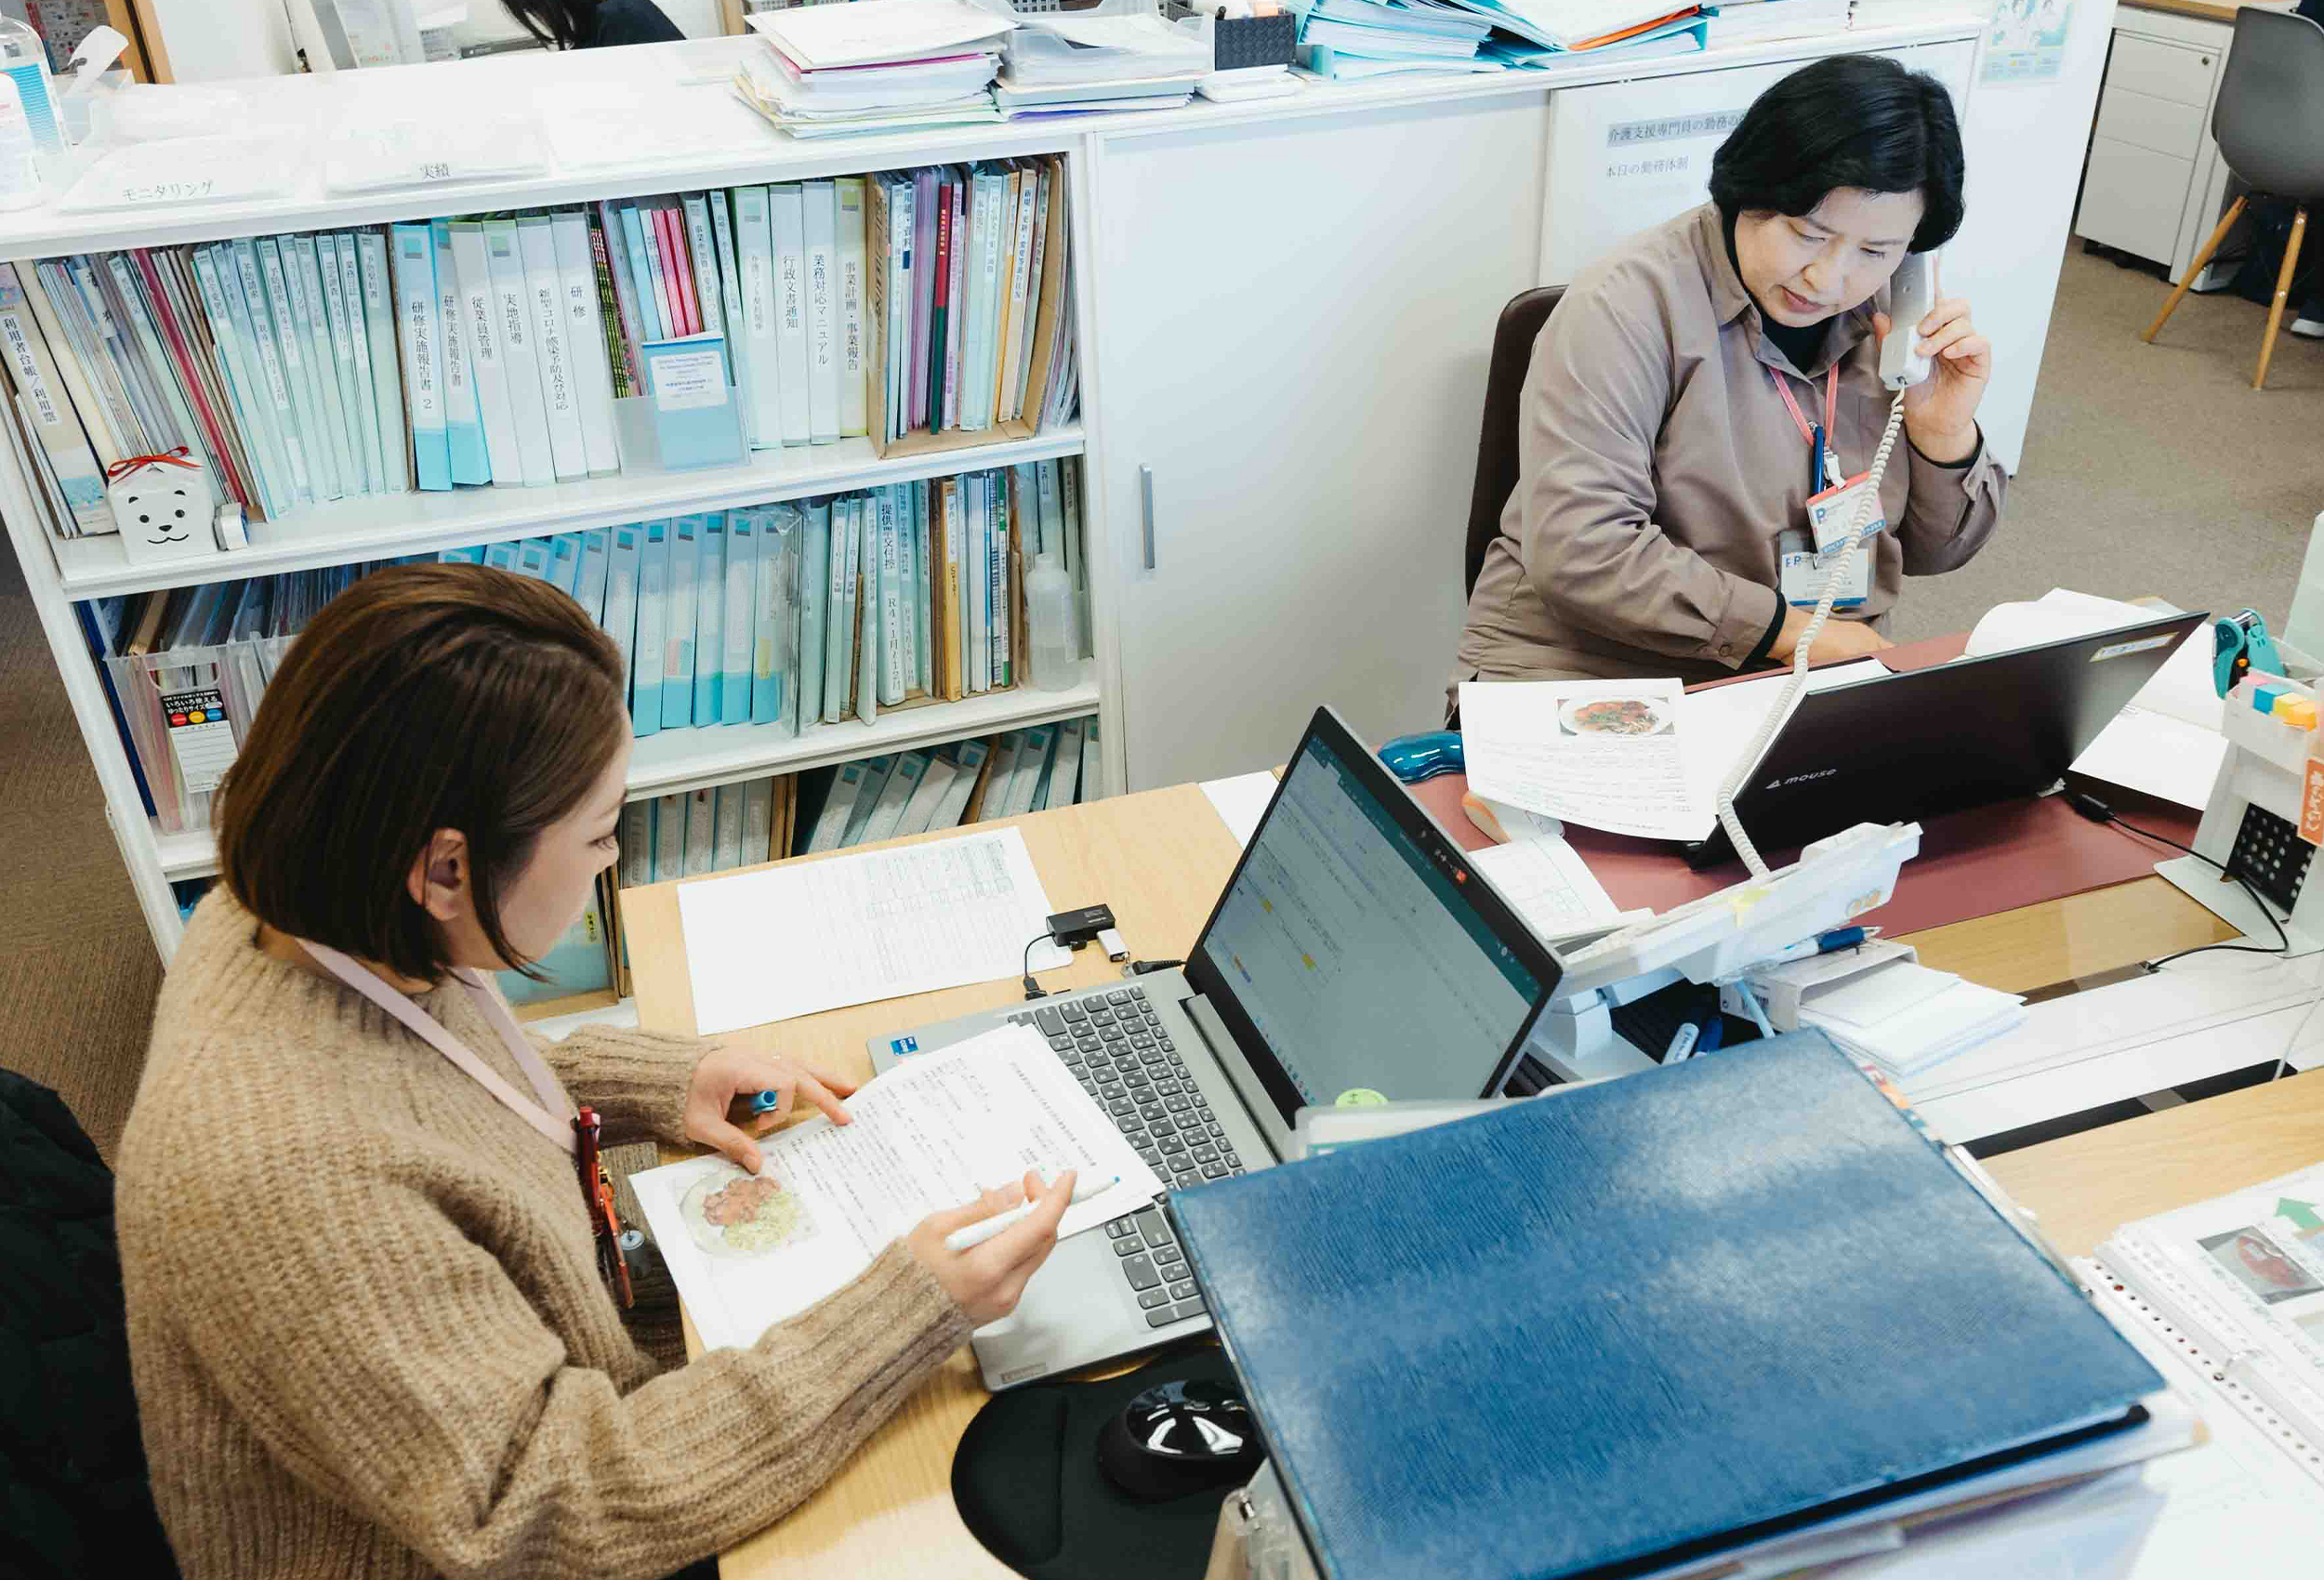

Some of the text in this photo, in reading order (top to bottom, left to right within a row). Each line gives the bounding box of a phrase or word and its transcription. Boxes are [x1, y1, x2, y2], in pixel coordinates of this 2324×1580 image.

[122, 178, 214, 203] モニタリング
[502, 293, 522, 345] 実地指導
[783, 255, 799, 330] 行政文書通知
[812, 254, 830, 366] 業務対応マニュアル
[844, 260, 860, 372] 事業計画・事業報告
[411, 301, 433, 391] 研修実施報告書
[442, 295, 463, 387] 研修実施報告書
[470, 296, 494, 360] 従業員管理
[538, 288, 570, 411] 新型コロナ感染予防及び対応
[165, 695, 218, 708] いろいろ使える
[167, 704, 206, 714] ゆったりサイズ
[1783, 768, 1838, 785] mouse
